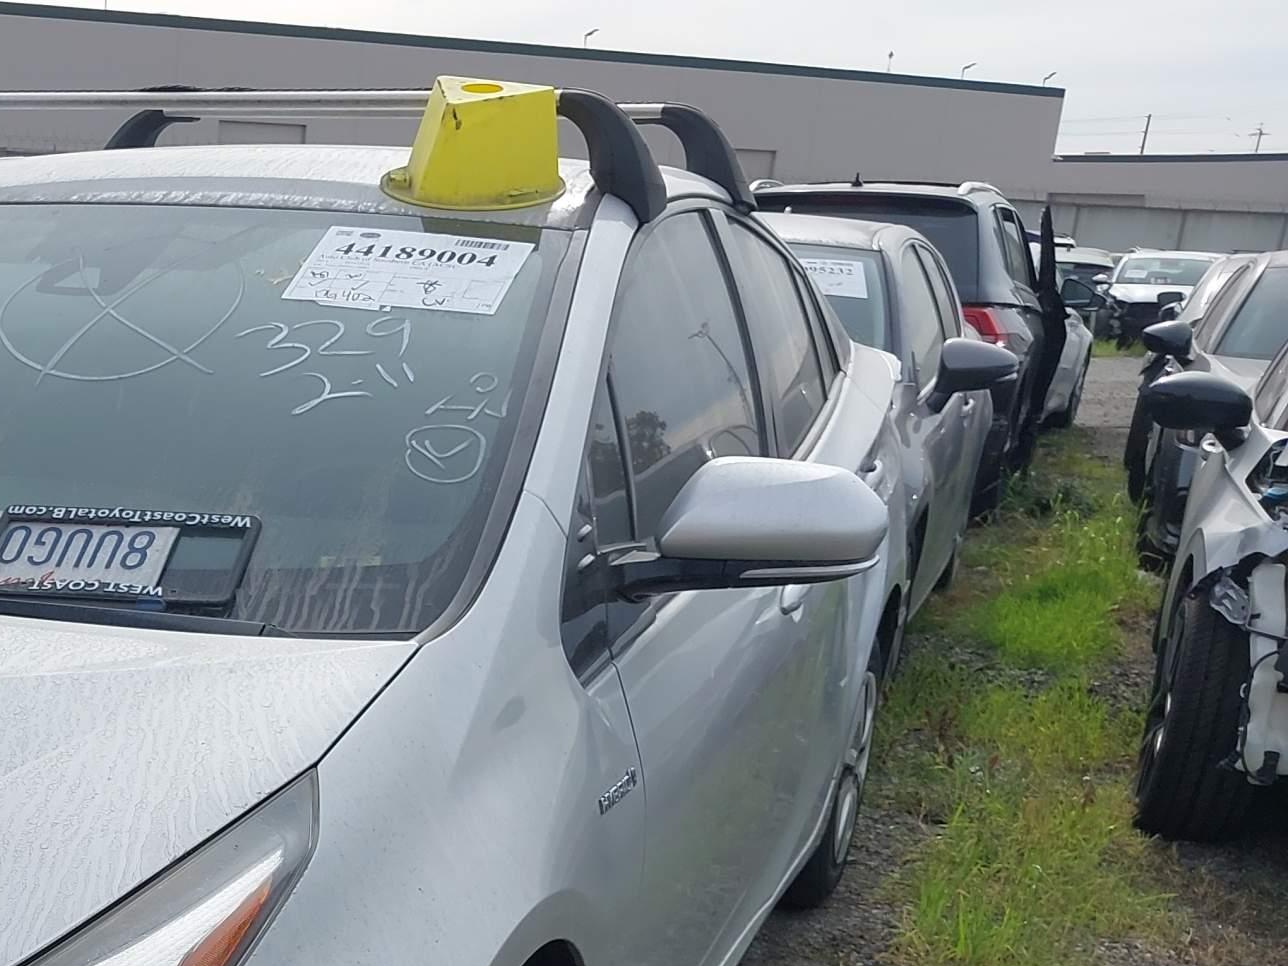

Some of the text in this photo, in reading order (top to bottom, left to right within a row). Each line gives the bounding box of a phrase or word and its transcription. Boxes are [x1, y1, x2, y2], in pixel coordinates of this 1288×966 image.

[335, 242, 498, 268] 44189004
[235, 316, 412, 377] 329
[7, 504, 253, 529] WestCoastToyotaLB.com
[28, 575, 100, 592] COAST
[104, 581, 164, 597] WEST
